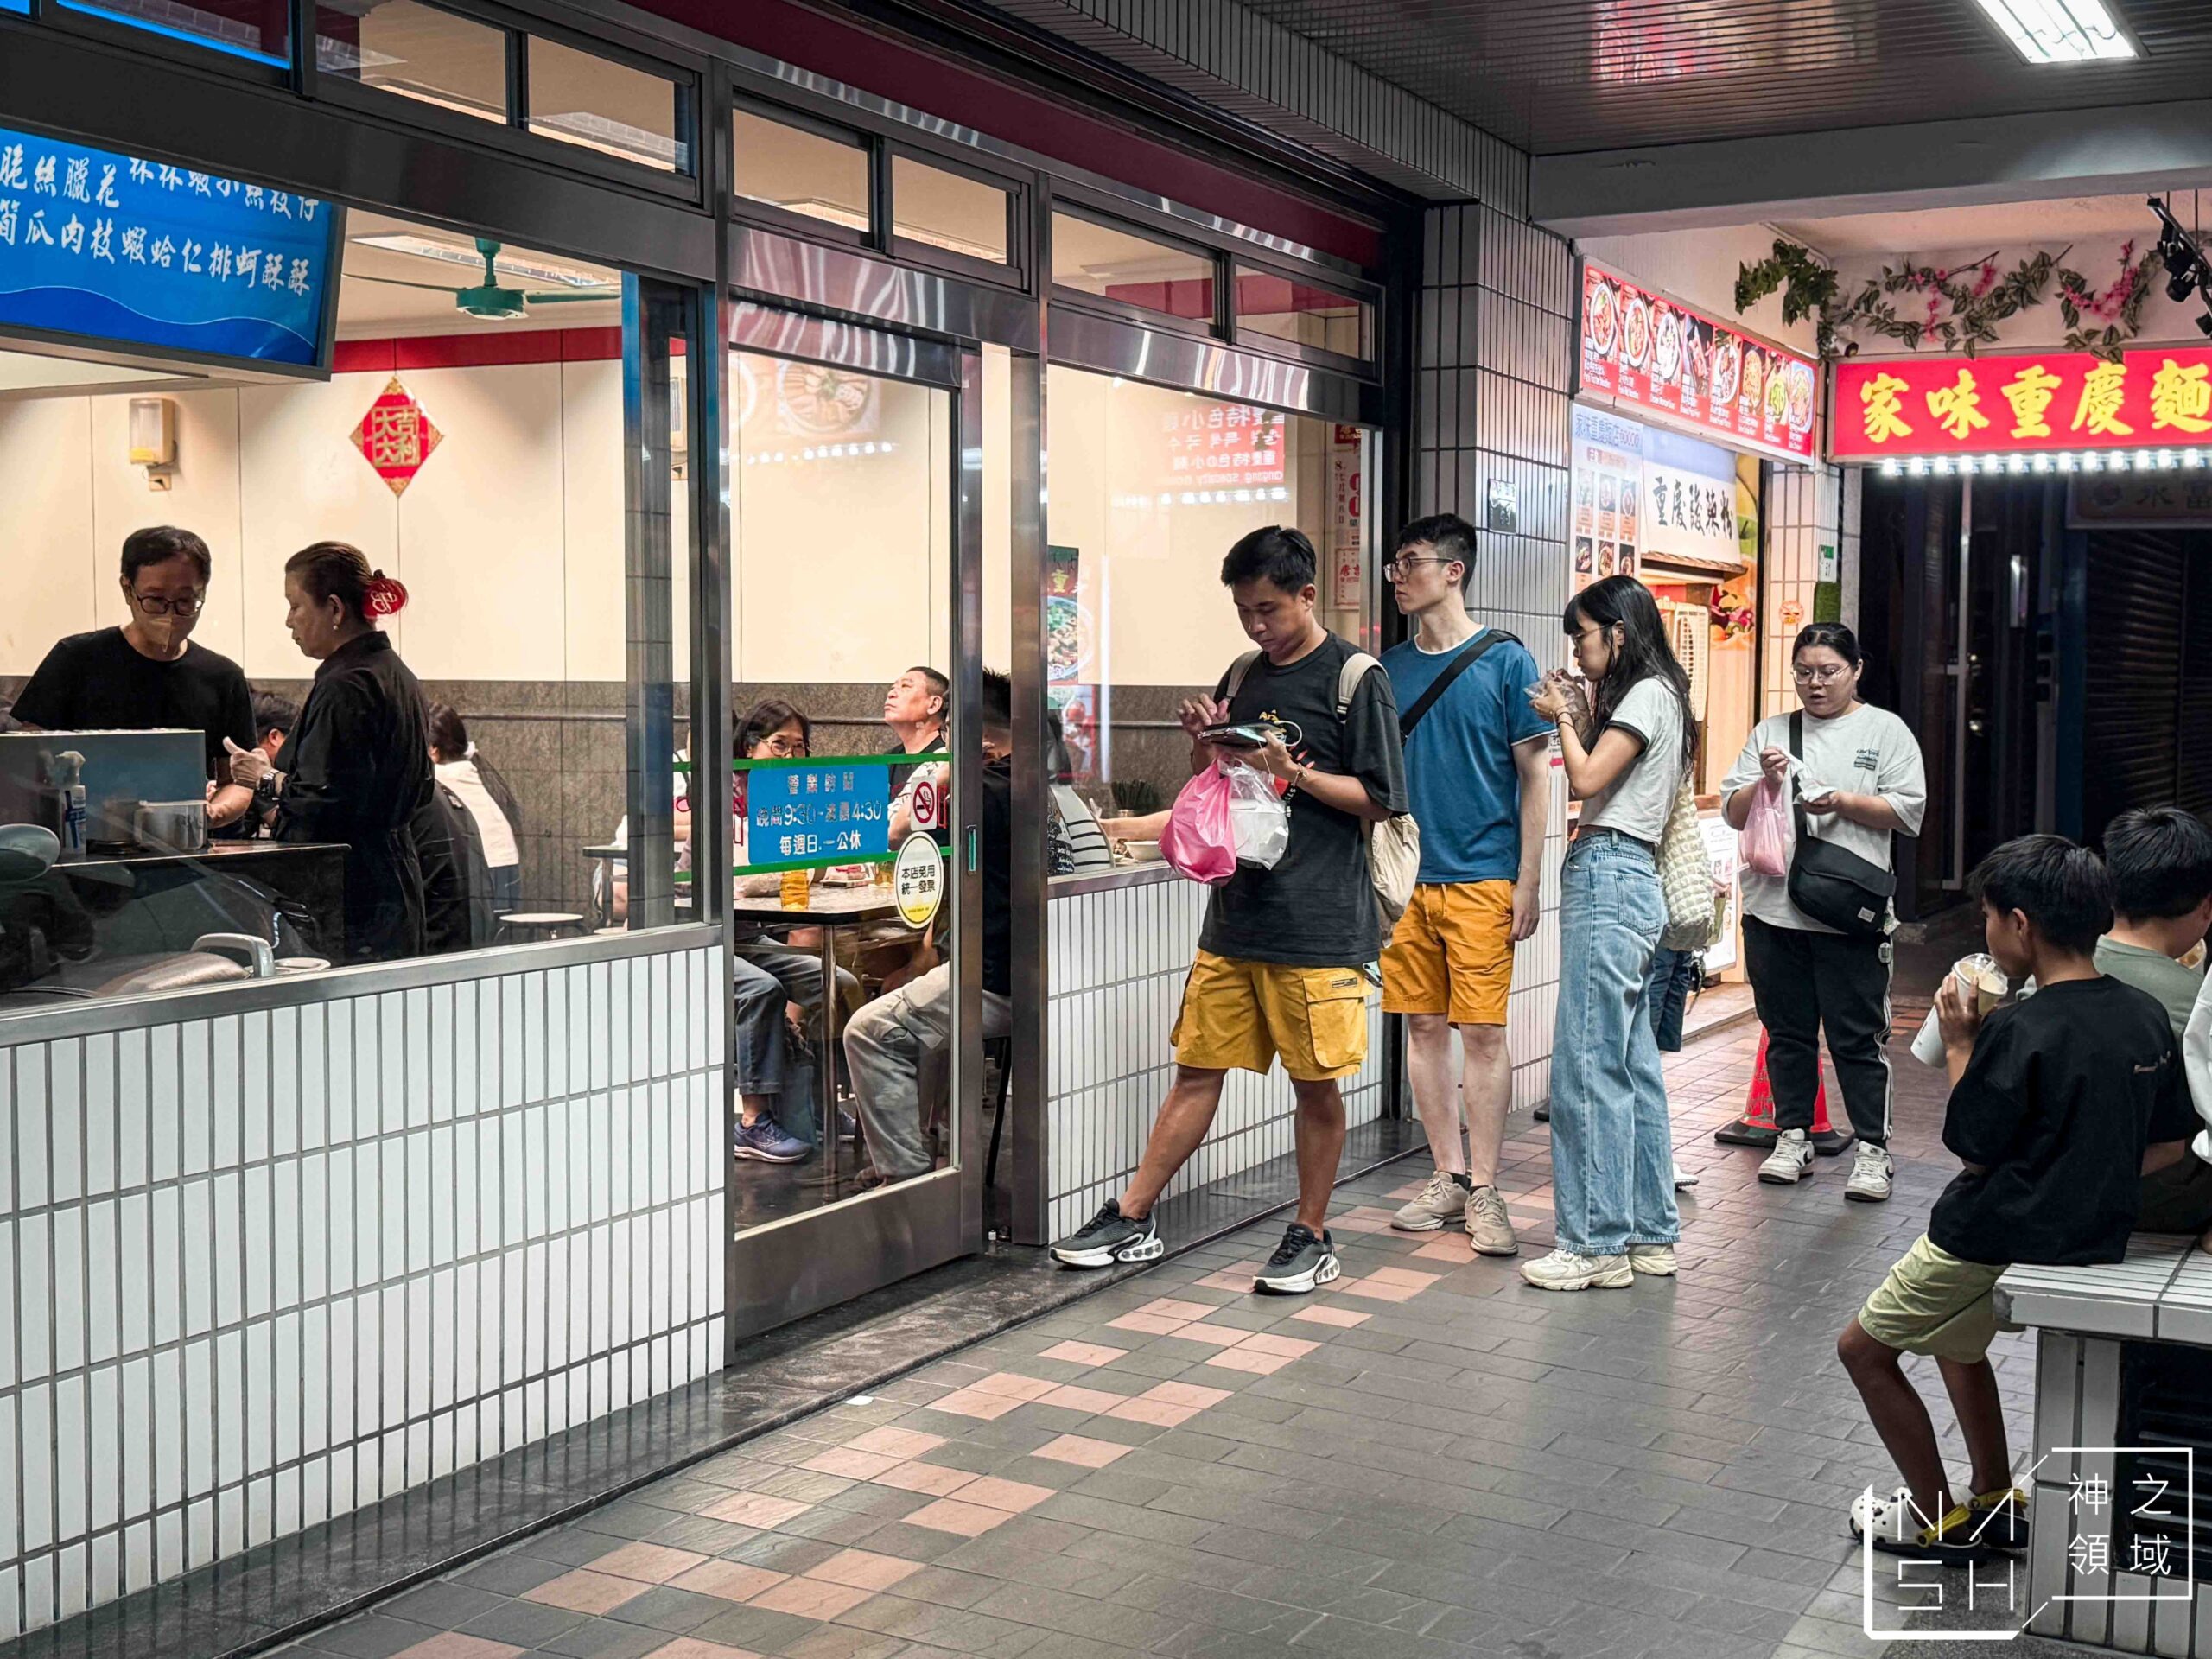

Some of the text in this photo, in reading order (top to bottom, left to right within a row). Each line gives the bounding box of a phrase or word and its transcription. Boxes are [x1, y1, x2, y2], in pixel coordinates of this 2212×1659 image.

[1860, 359, 2212, 443] 家味重慶麵
[901, 865, 935, 880] 本店免用
[901, 880, 936, 895] 統一發票
